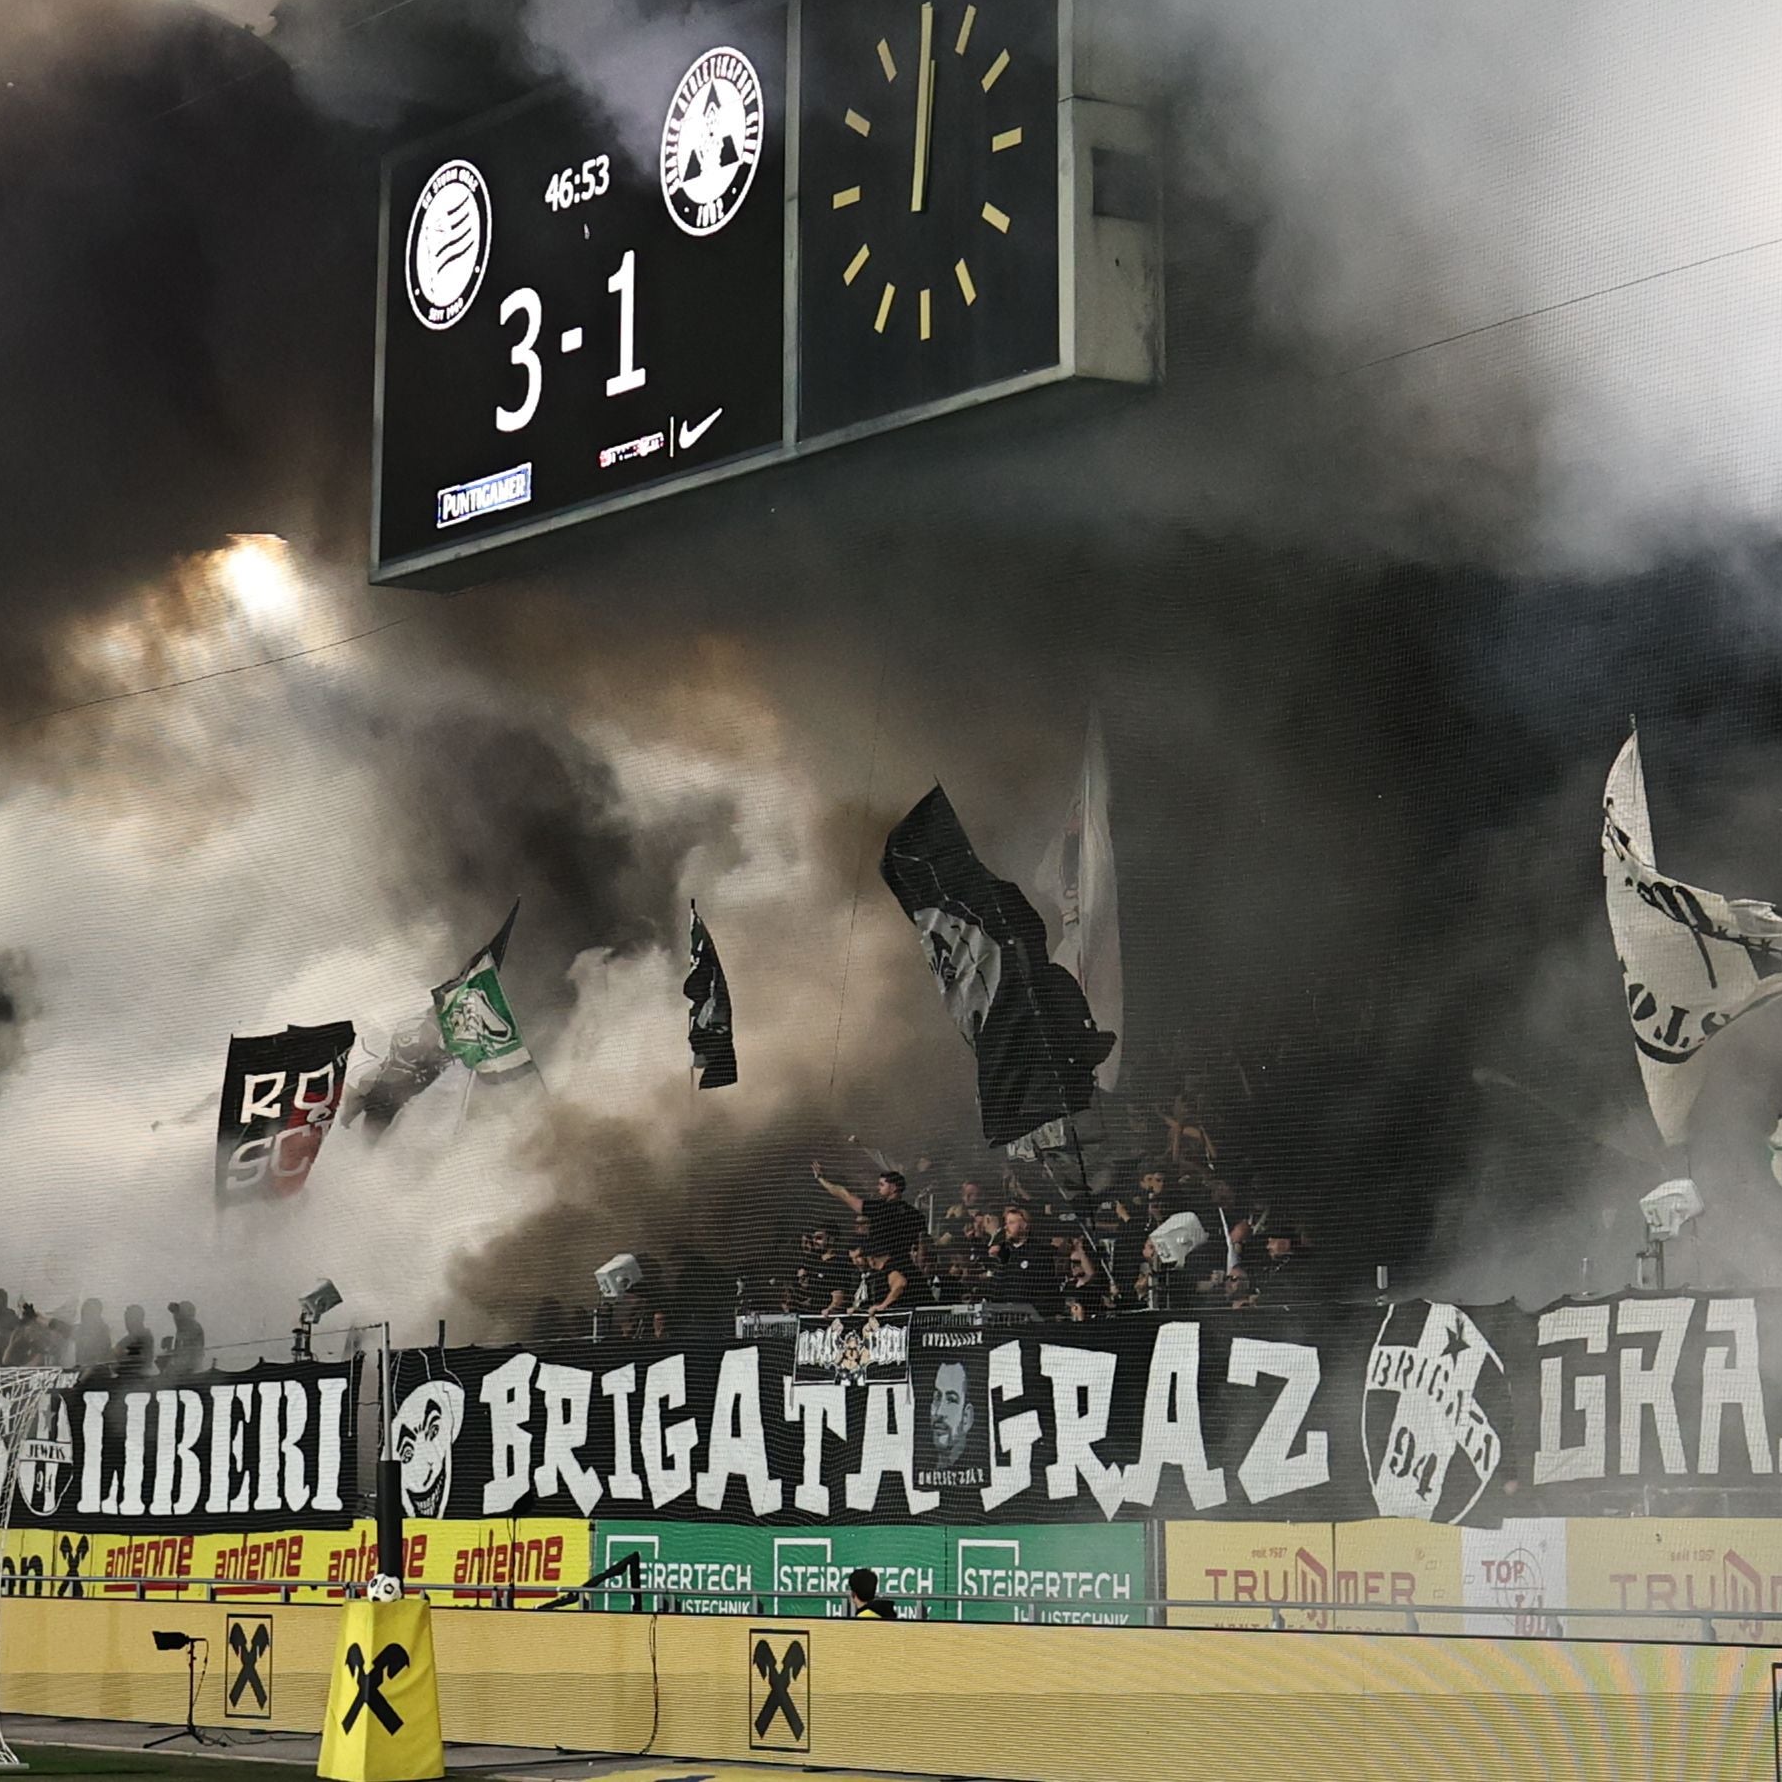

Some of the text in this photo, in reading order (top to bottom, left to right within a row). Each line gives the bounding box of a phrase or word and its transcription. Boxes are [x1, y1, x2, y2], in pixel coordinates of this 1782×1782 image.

[544, 154, 610, 212] 46:53
[442, 473, 527, 521] PUNTIGAMER
[77, 1377, 348, 1516] LIBERI
[479, 1321, 1331, 1521] BRIGATA GRAZ
[104, 1534, 195, 1579] antenne
[214, 1533, 304, 1581] antenne
[453, 1529, 564, 1584] antenne
[1481, 1560, 1526, 1584] TOP
